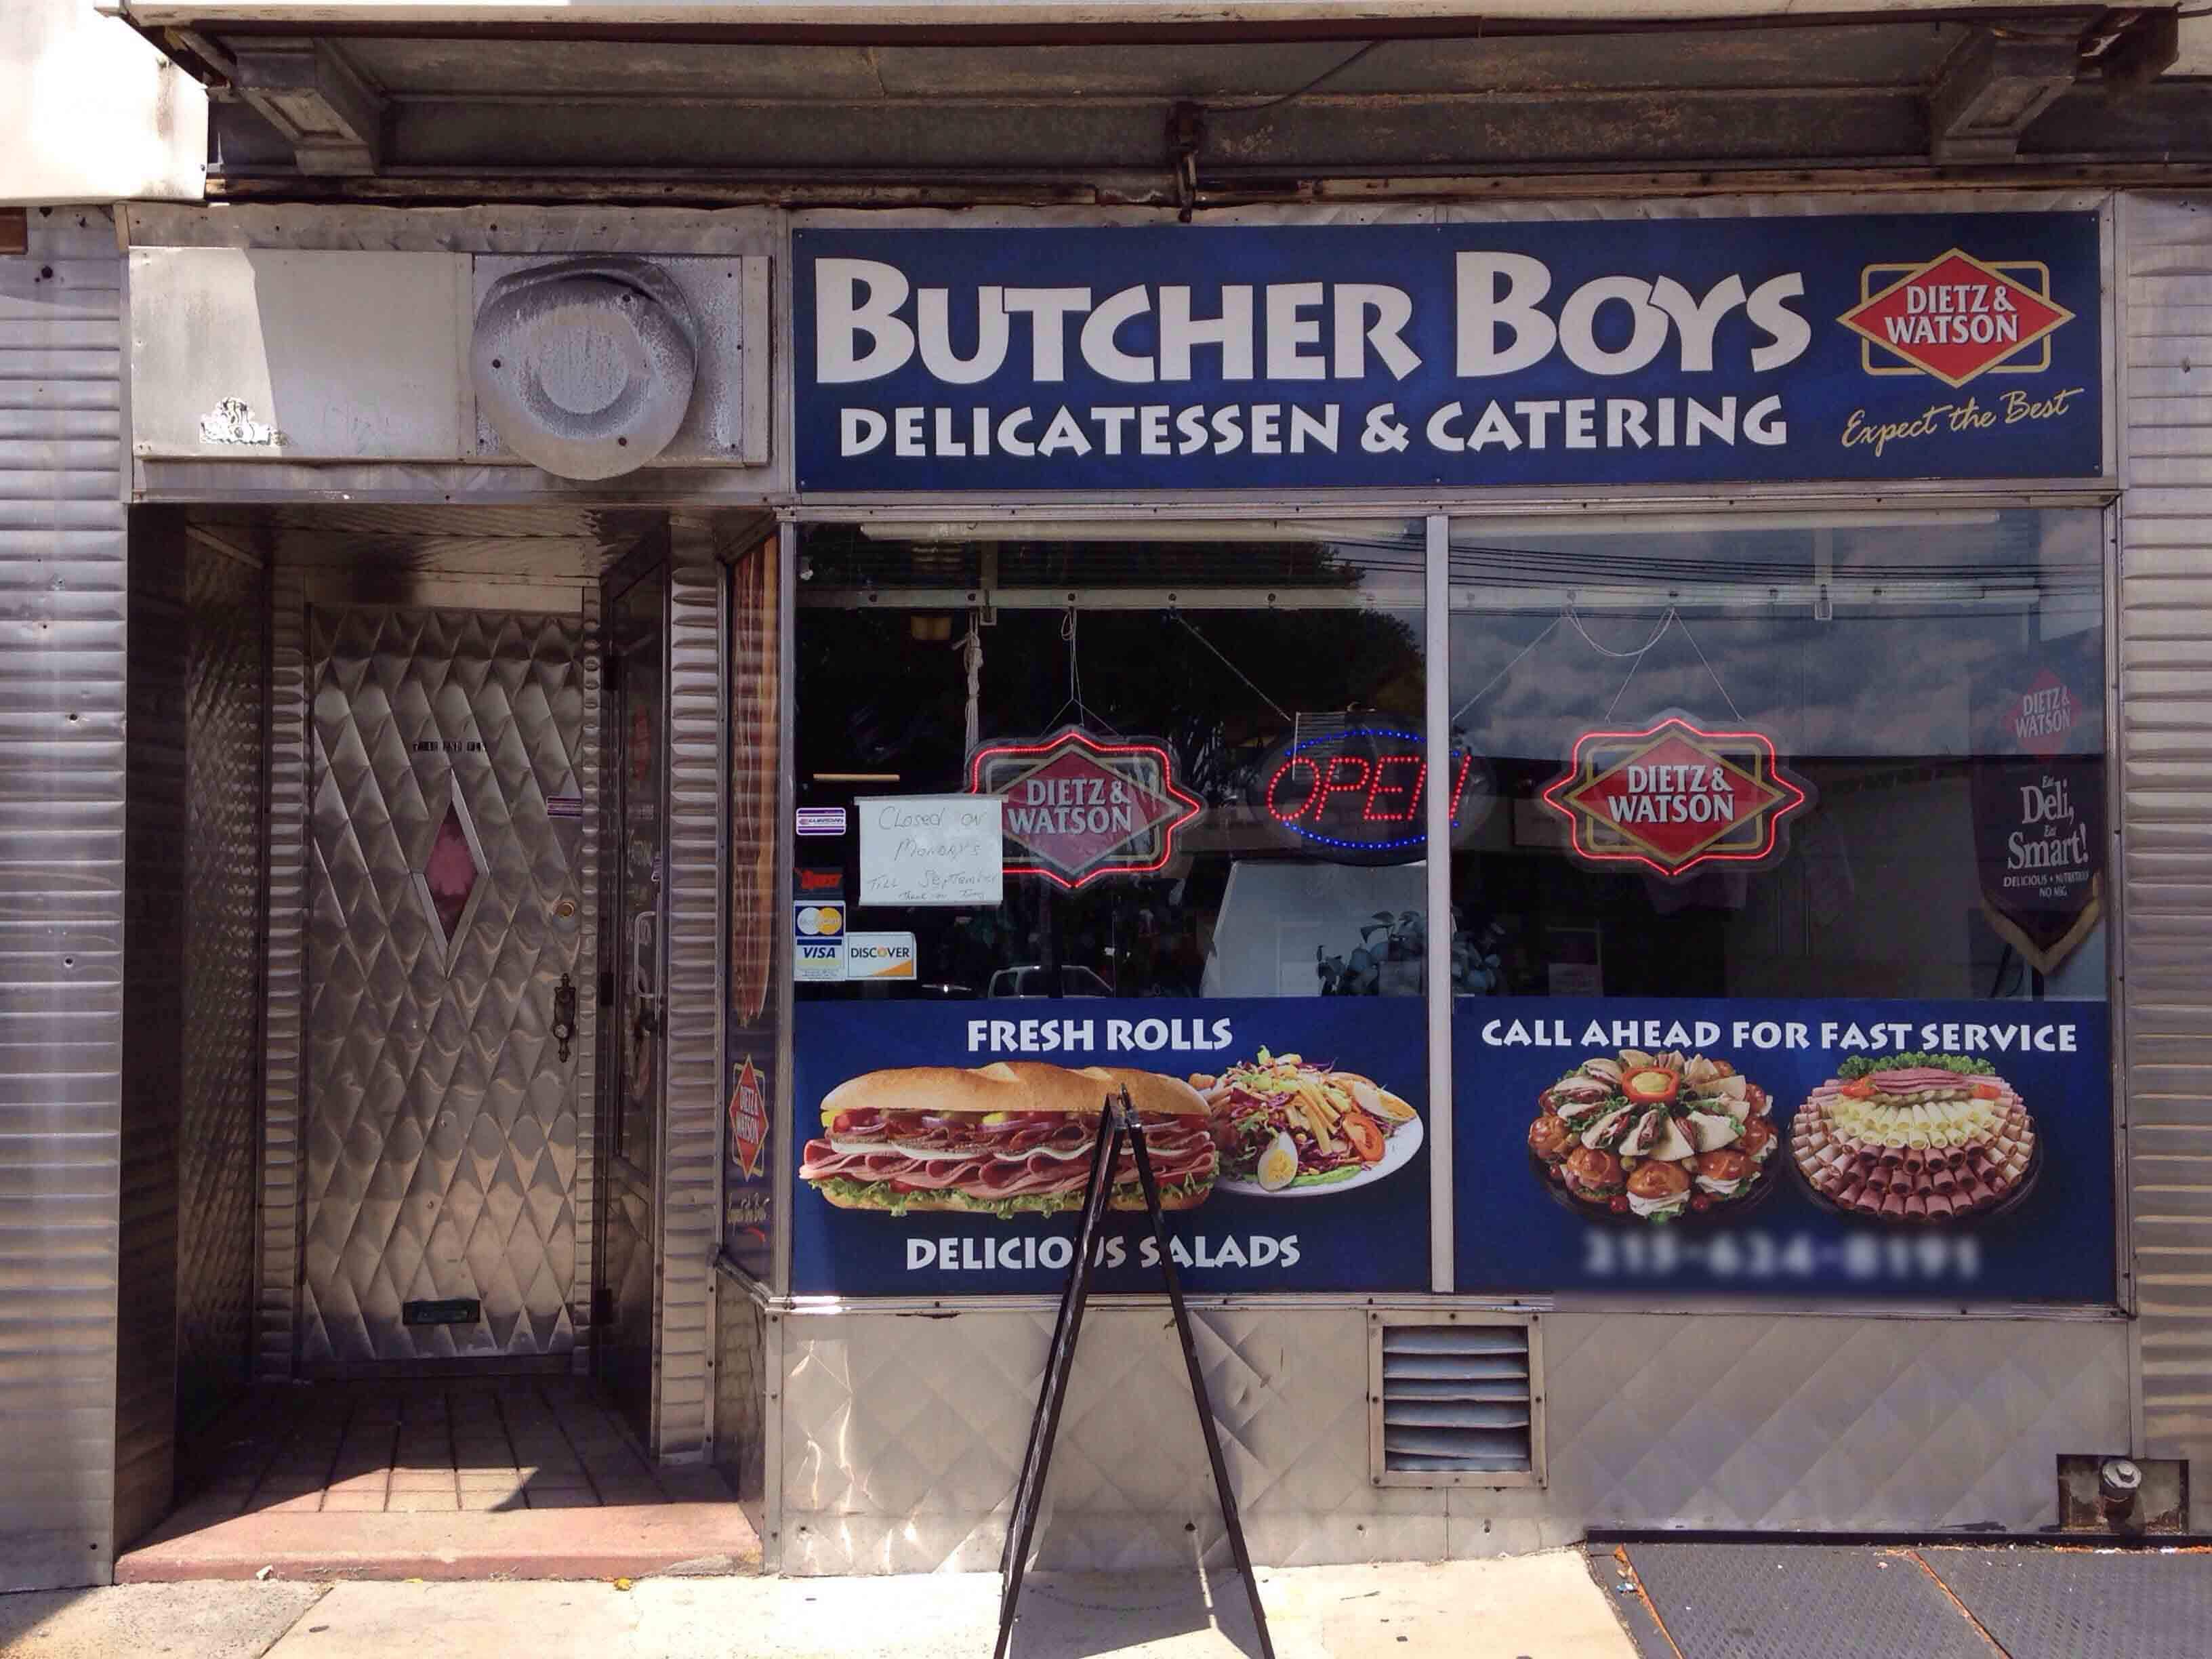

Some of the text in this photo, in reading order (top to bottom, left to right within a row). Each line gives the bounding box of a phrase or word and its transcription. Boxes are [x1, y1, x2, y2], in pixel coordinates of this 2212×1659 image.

[1906, 285, 2018, 314] DIETZ &
[815, 251, 1811, 384] BUTCHER BOYS
[1885, 314, 2019, 344] WATSON
[841, 395, 1787, 457] DELICATESSEN & CATERING
[1841, 388, 2085, 457] Expect the Best
[2023, 687, 2060, 716] DIETZ
[2017, 710, 2071, 738] WATSON
[1026, 779, 1132, 806] DIETZ &
[1628, 764, 1733, 793] DIETZ &
[1608, 794, 1735, 823] WATSON
[2020, 779, 2074, 825] Deli,
[1007, 806, 1132, 835] WATSON
[2007, 822, 2089, 869] Smart!
[803, 947, 836, 958] VISA
[851, 946, 910, 958] DISCOVER
[968, 1018, 1233, 1052] FRESH ROLLS
[1481, 1019, 2077, 1054] CALL AHEAD FOR FAST SERVICE
[1140, 1234, 1300, 1268] SALADS
